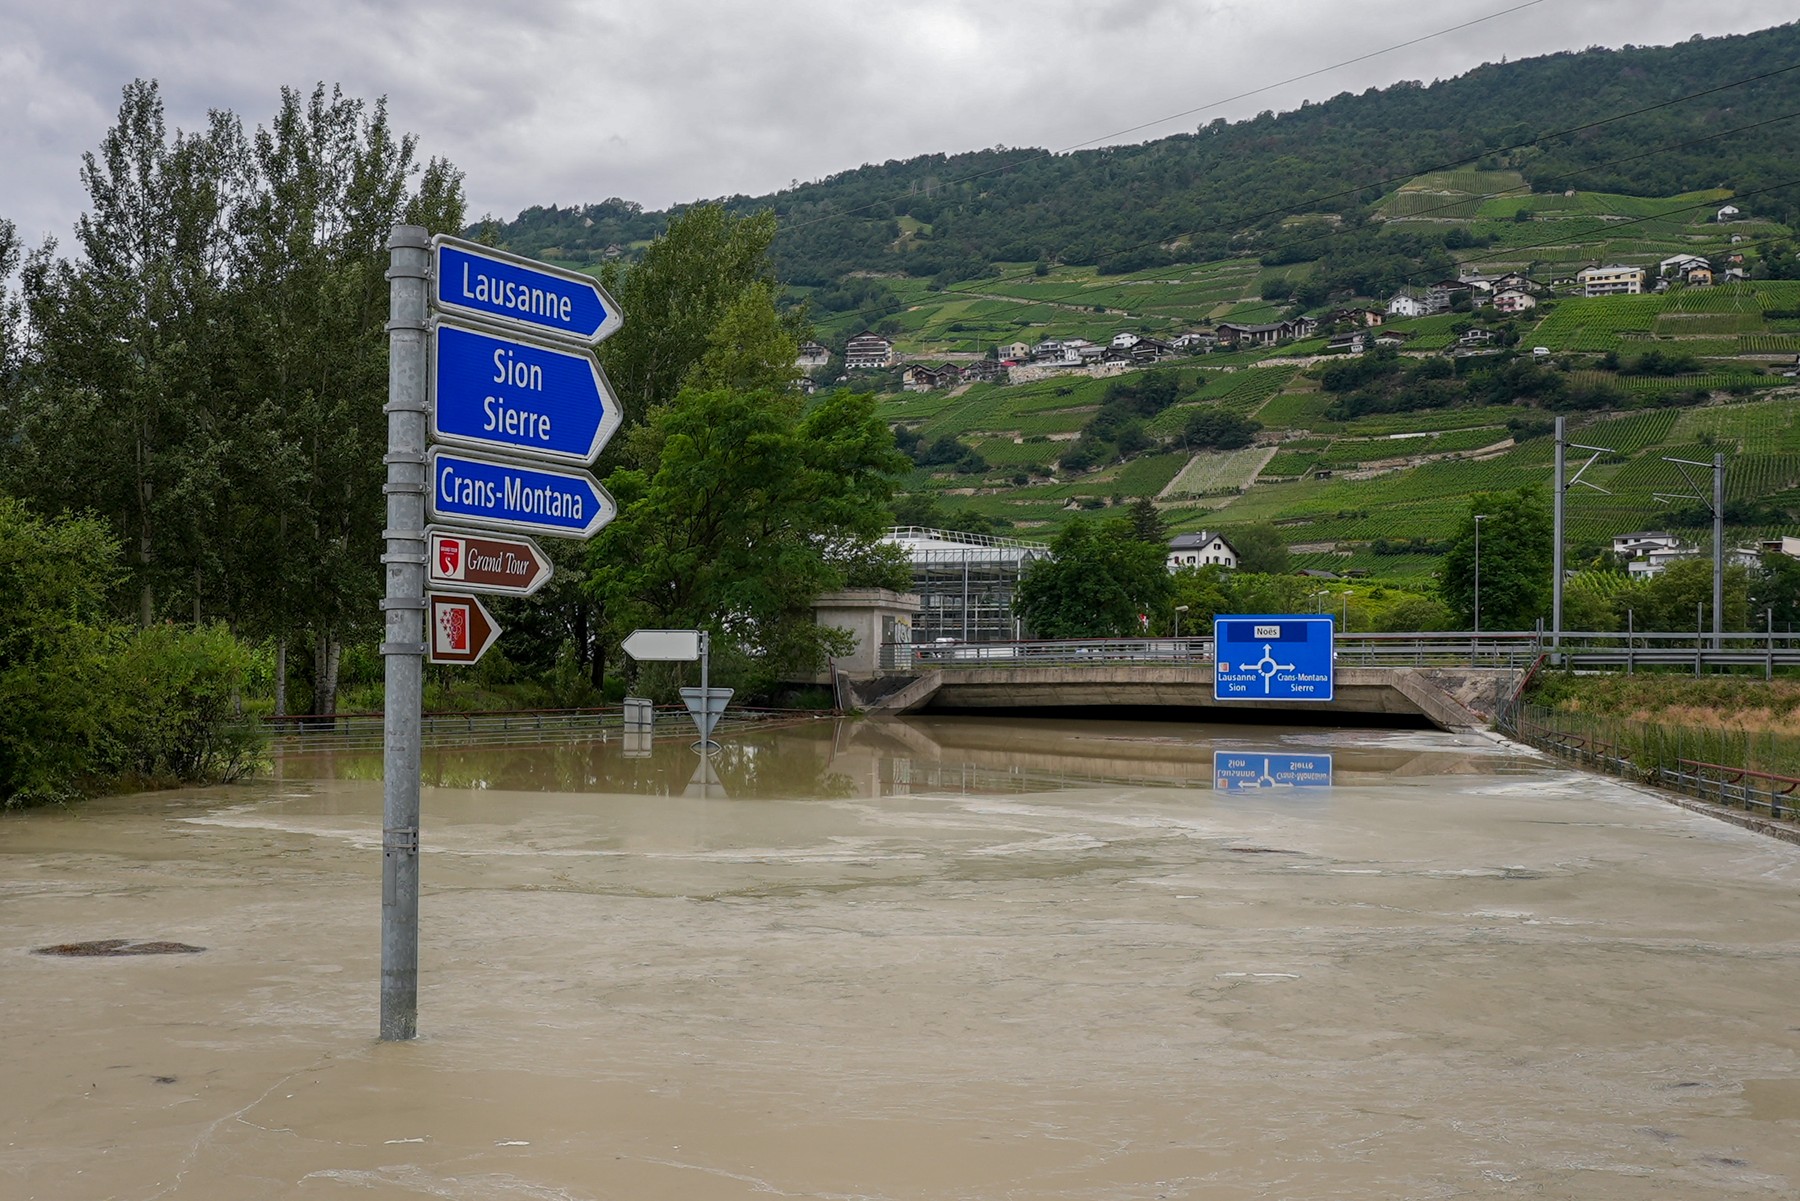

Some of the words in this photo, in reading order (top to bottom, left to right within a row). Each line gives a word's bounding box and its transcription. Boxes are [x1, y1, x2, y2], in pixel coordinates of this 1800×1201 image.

[462, 261, 572, 322] Lausanne
[493, 348, 543, 392] Sion
[483, 396, 551, 441] Sierre
[440, 466, 583, 520] Crans-Montana
[467, 547, 503, 574] Grand
[505, 552, 530, 576] Tour
[1218, 673, 1257, 682] Lausanne
[1228, 682, 1247, 692] Sion
[1277, 672, 1328, 682] Crans-Montana
[1290, 683, 1315, 693] Sierre
